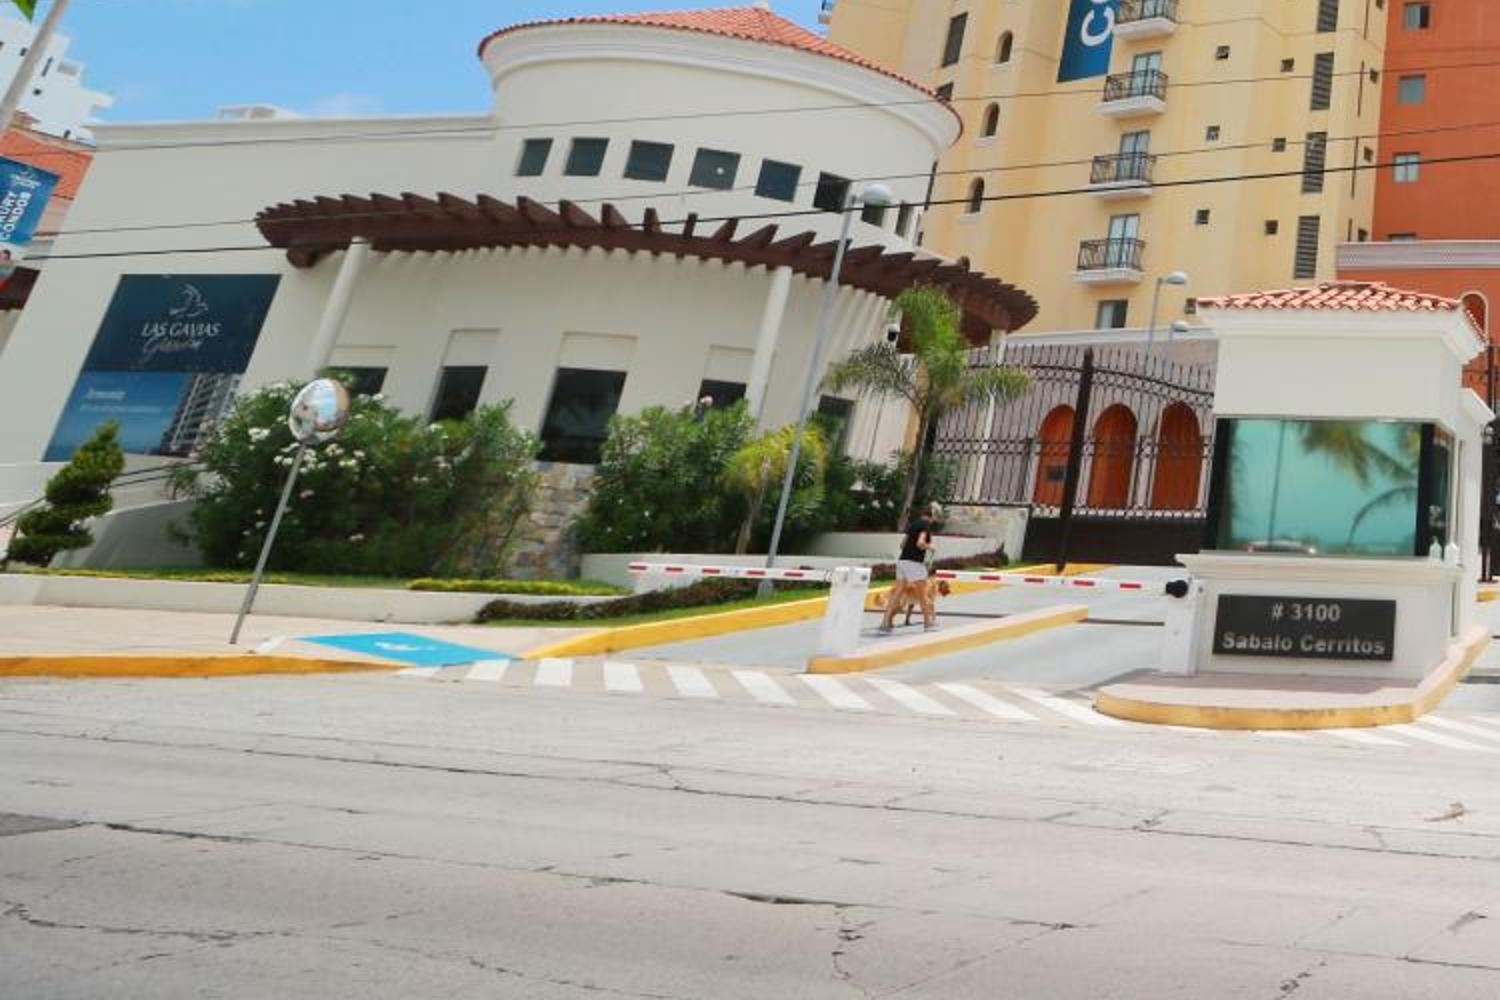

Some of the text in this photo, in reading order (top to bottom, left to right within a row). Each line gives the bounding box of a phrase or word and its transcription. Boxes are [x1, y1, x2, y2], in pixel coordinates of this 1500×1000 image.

[141, 321, 222, 337] LAS GAVIAS
[1290, 603, 1341, 622] 3100
[1222, 631, 1385, 655] Sabalo Cerritos
